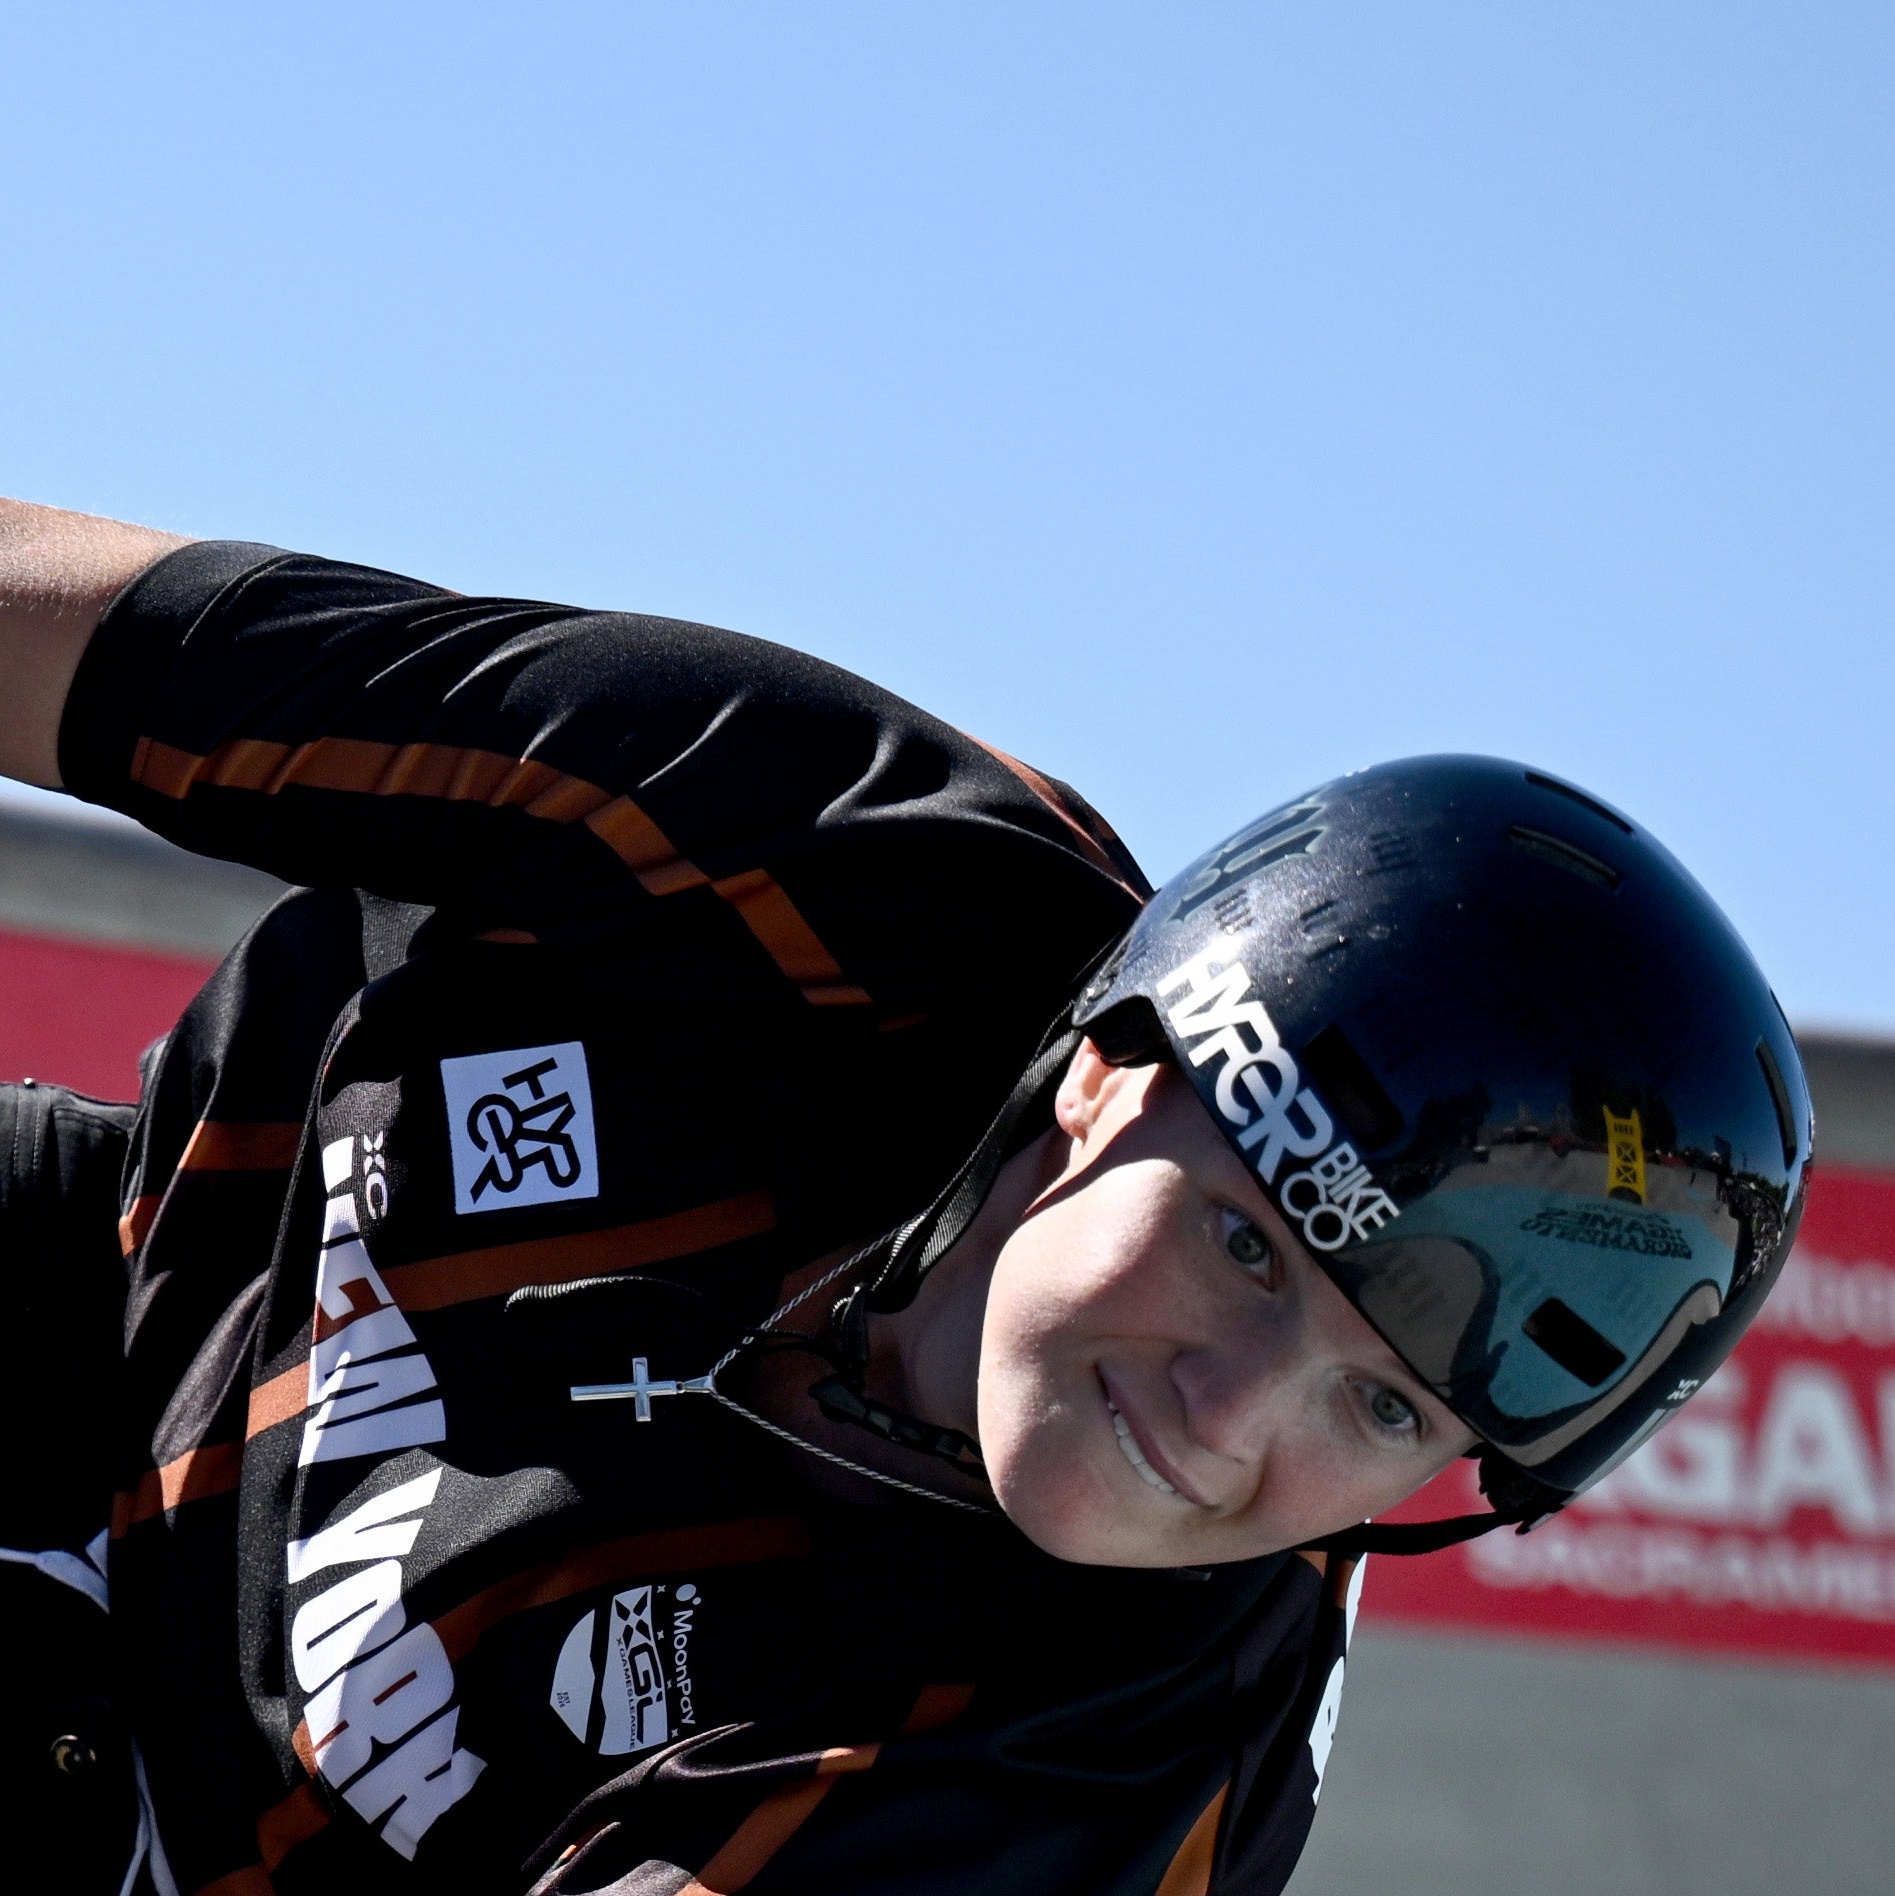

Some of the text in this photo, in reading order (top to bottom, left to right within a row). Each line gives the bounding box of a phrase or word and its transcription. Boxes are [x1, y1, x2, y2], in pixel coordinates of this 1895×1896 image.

[1280, 1170, 1351, 1251] CO
[1311, 1140, 1401, 1242] BIKE
[286, 1466, 489, 1862] YORK
[613, 1590, 664, 1745] XGL
[673, 1609, 697, 1725] MoonPay
